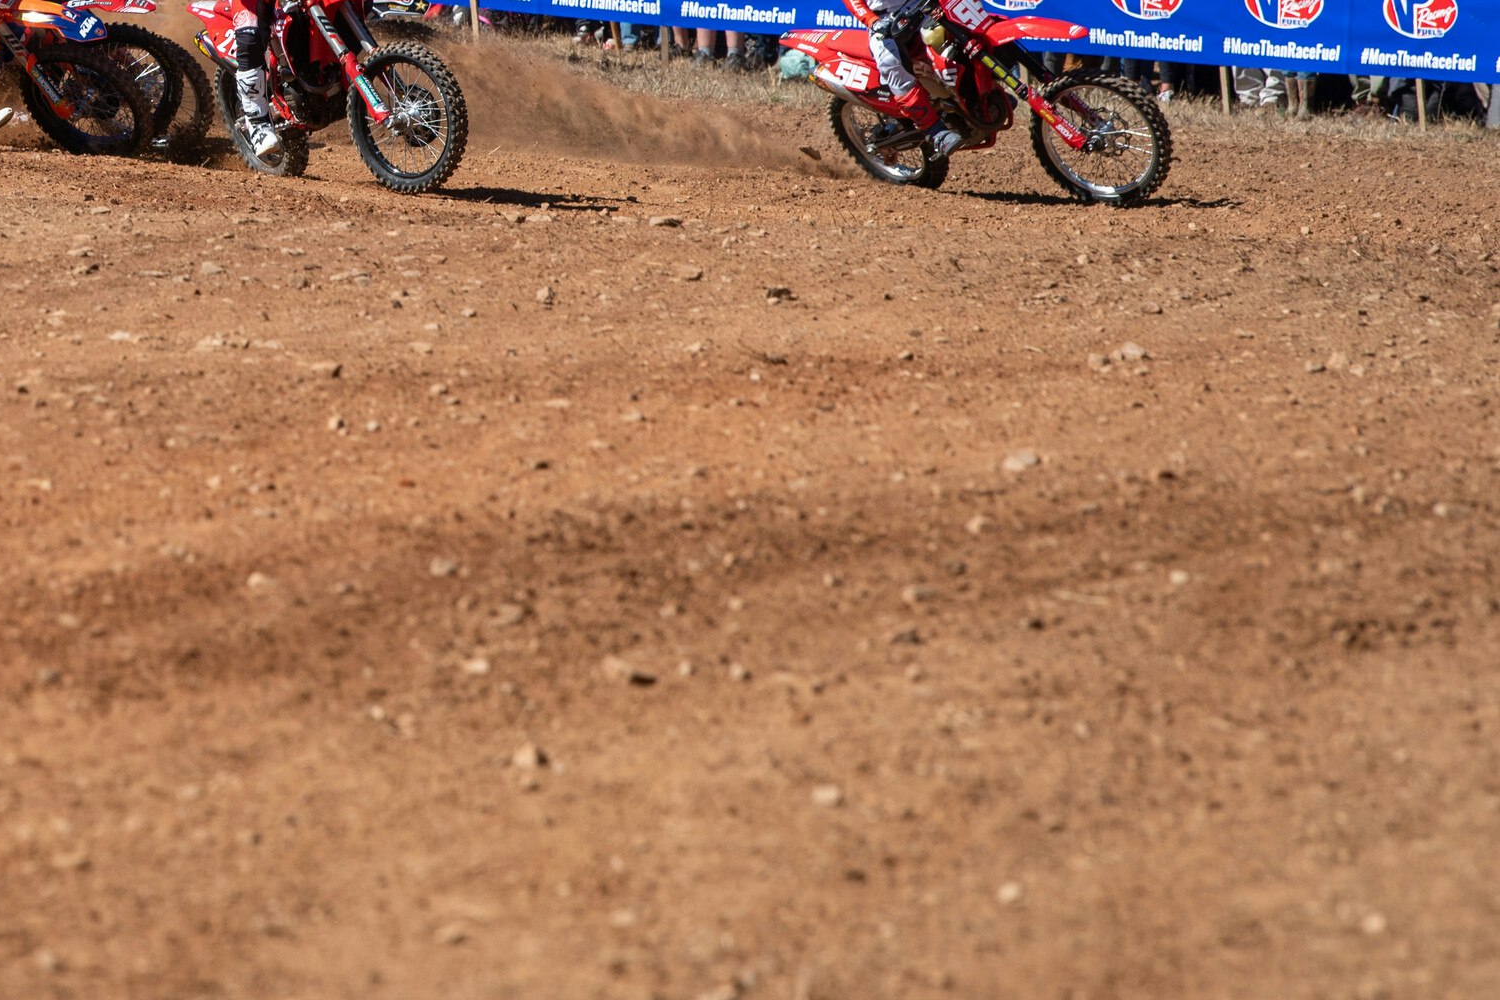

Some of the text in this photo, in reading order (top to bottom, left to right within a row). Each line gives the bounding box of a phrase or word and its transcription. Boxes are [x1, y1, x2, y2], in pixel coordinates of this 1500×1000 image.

[681, 0, 796, 24] #MoreThanRaceFuel
[1281, 18, 1308, 27] FUELS
[1417, 6, 1457, 27] Racing
[79, 16, 98, 38] KTM
[1089, 28, 1203, 52] #MoreThanRaceFuel
[1223, 37, 1341, 62] #MoreThanRaceFuel
[1360, 47, 1477, 72] #MoreThanRaceFuel
[834, 60, 871, 91] 515
